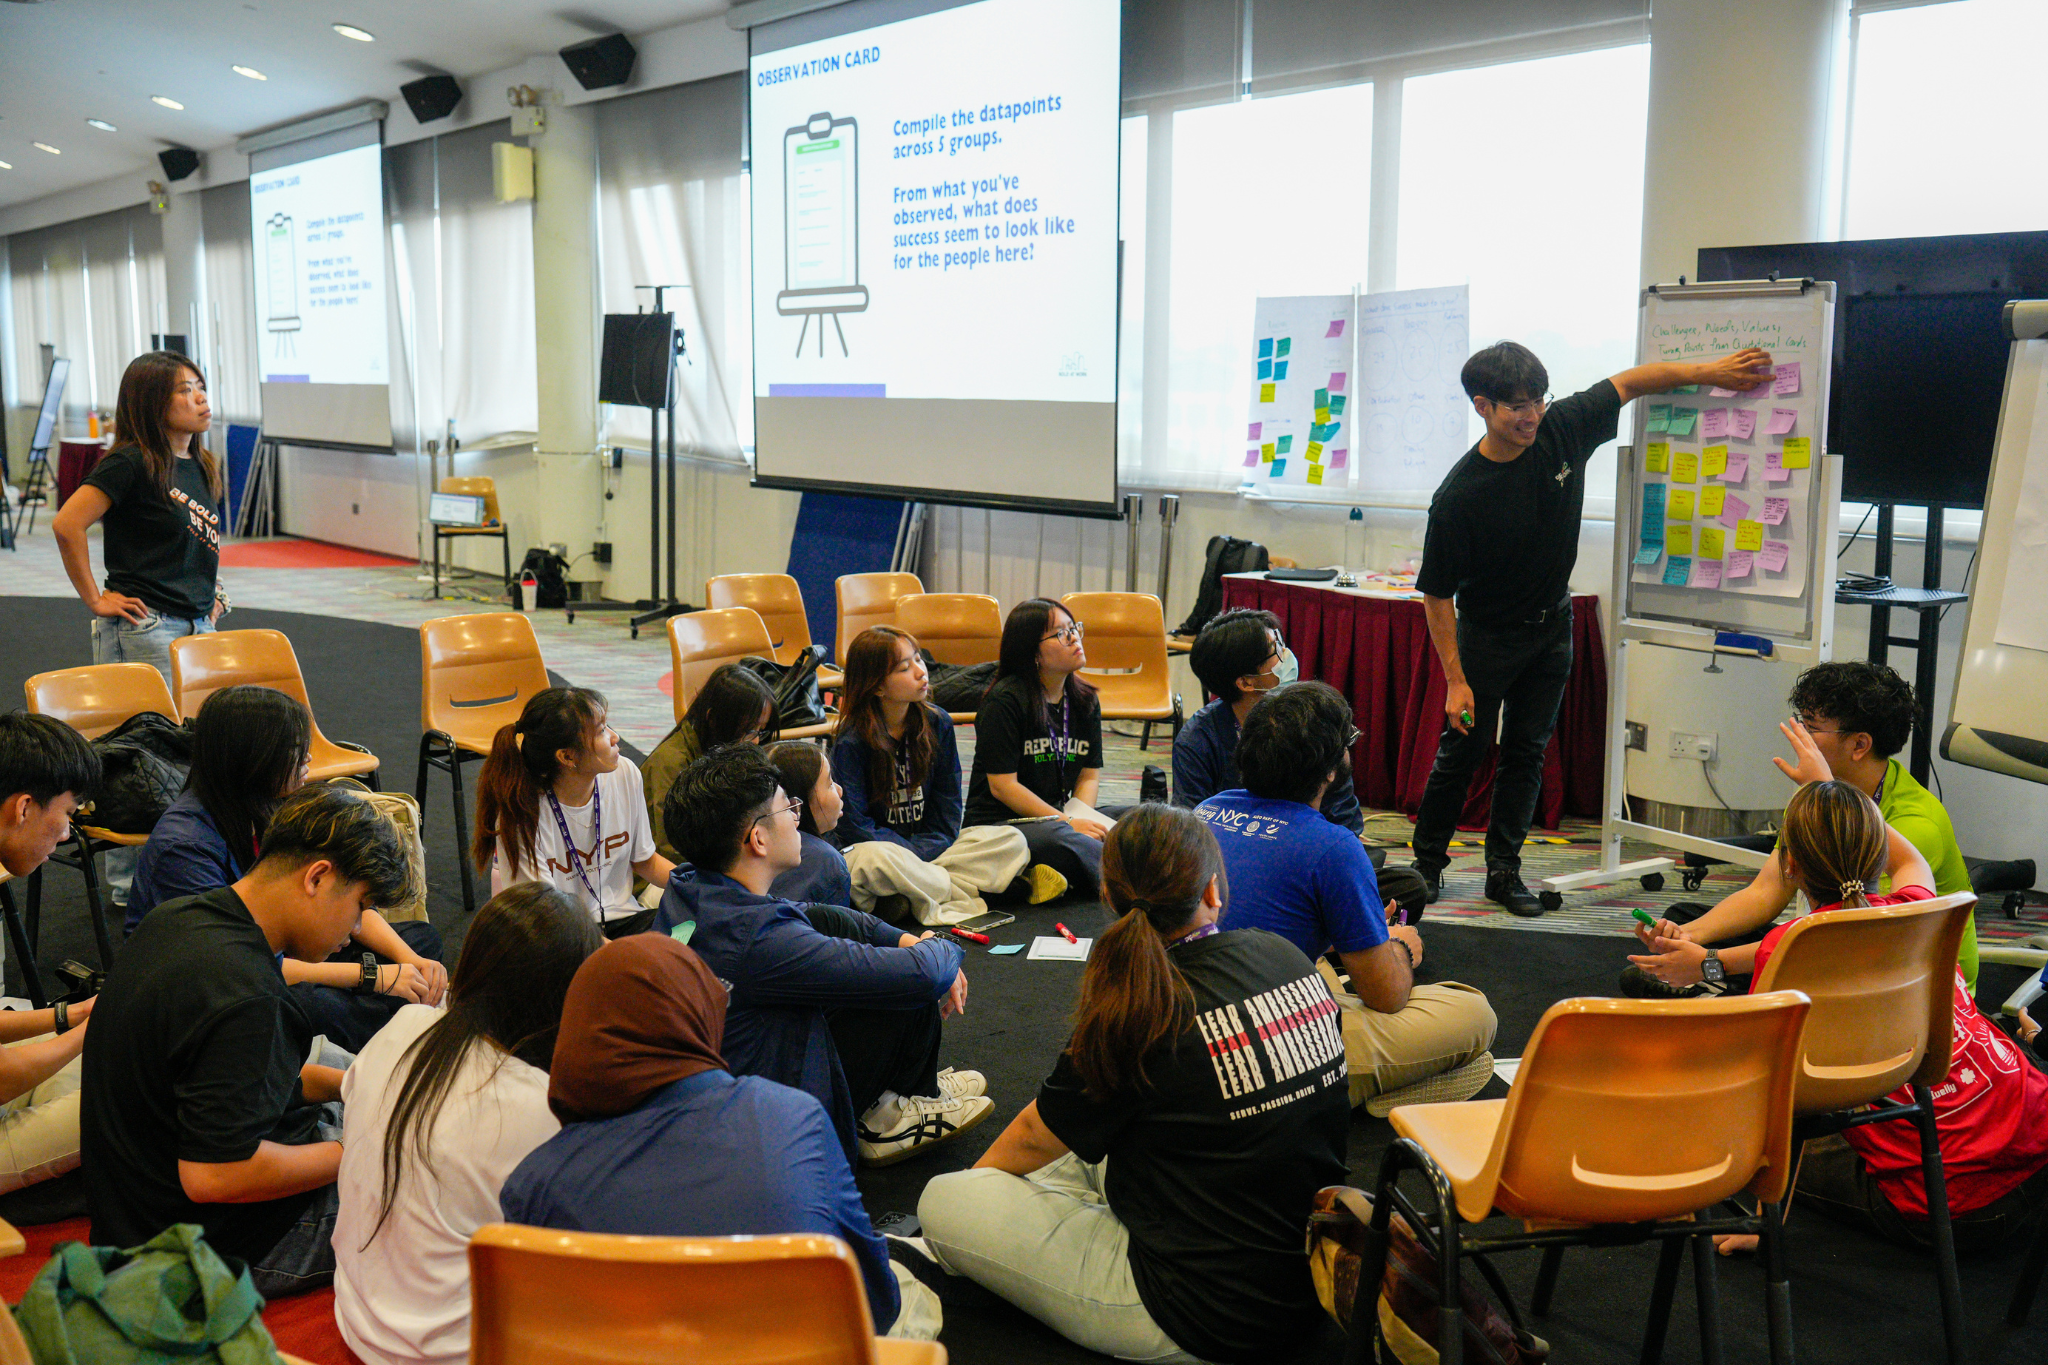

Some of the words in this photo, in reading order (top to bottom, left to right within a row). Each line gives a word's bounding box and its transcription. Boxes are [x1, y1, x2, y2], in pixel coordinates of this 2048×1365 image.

[758, 55, 840, 86] OBSERVATION
[845, 46, 880, 68] CARD
[894, 114, 946, 137] Compile
[952, 109, 974, 127] the
[980, 95, 1062, 123] datapoints
[893, 140, 933, 159] across
[938, 136, 944, 152] 5
[950, 130, 1002, 156] groups.
[894, 187, 927, 203] From
[932, 180, 966, 198] what
[972, 174, 1020, 200] you've
[894, 203, 958, 225] observed,
[963, 200, 998, 218] what
[1004, 196, 1038, 214] does
[894, 230, 939, 247] success
[944, 227, 979, 243] seem
[984, 224, 1000, 240] to
[1006, 218, 1038, 238] look
[1045, 216, 1075, 234] like
[894, 254, 913, 270] for
[918, 251, 940, 268] the
[944, 246, 990, 272] people
[995, 242, 1034, 262] here?
[1706, 320, 1738, 334] Needs,
[1742, 320, 1780, 334] Values,
[1786, 336, 1806, 348] Cards
[170, 488, 189, 504] BE
[188, 498, 218, 524] BOLD
[190, 510, 204, 532] BE
[1215, 808, 1249, 826] NYC
[547, 831, 629, 877] NYP
[1196, 1004, 1239, 1029] LEAD
[1200, 1018, 1245, 1044] LEAD
[1207, 1032, 1250, 1057] LEAD
[1212, 1045, 1256, 1072] LEAD
[1215, 1059, 1260, 1086] LEAD
[1322, 1070, 1339, 1087] EST.
[1220, 1073, 1266, 1100] LEAD
[1230, 1106, 1260, 1120] SERVE.
[1261, 1094, 1296, 1112] PASSION.
[1295, 1084, 1316, 1100] DRIVE
